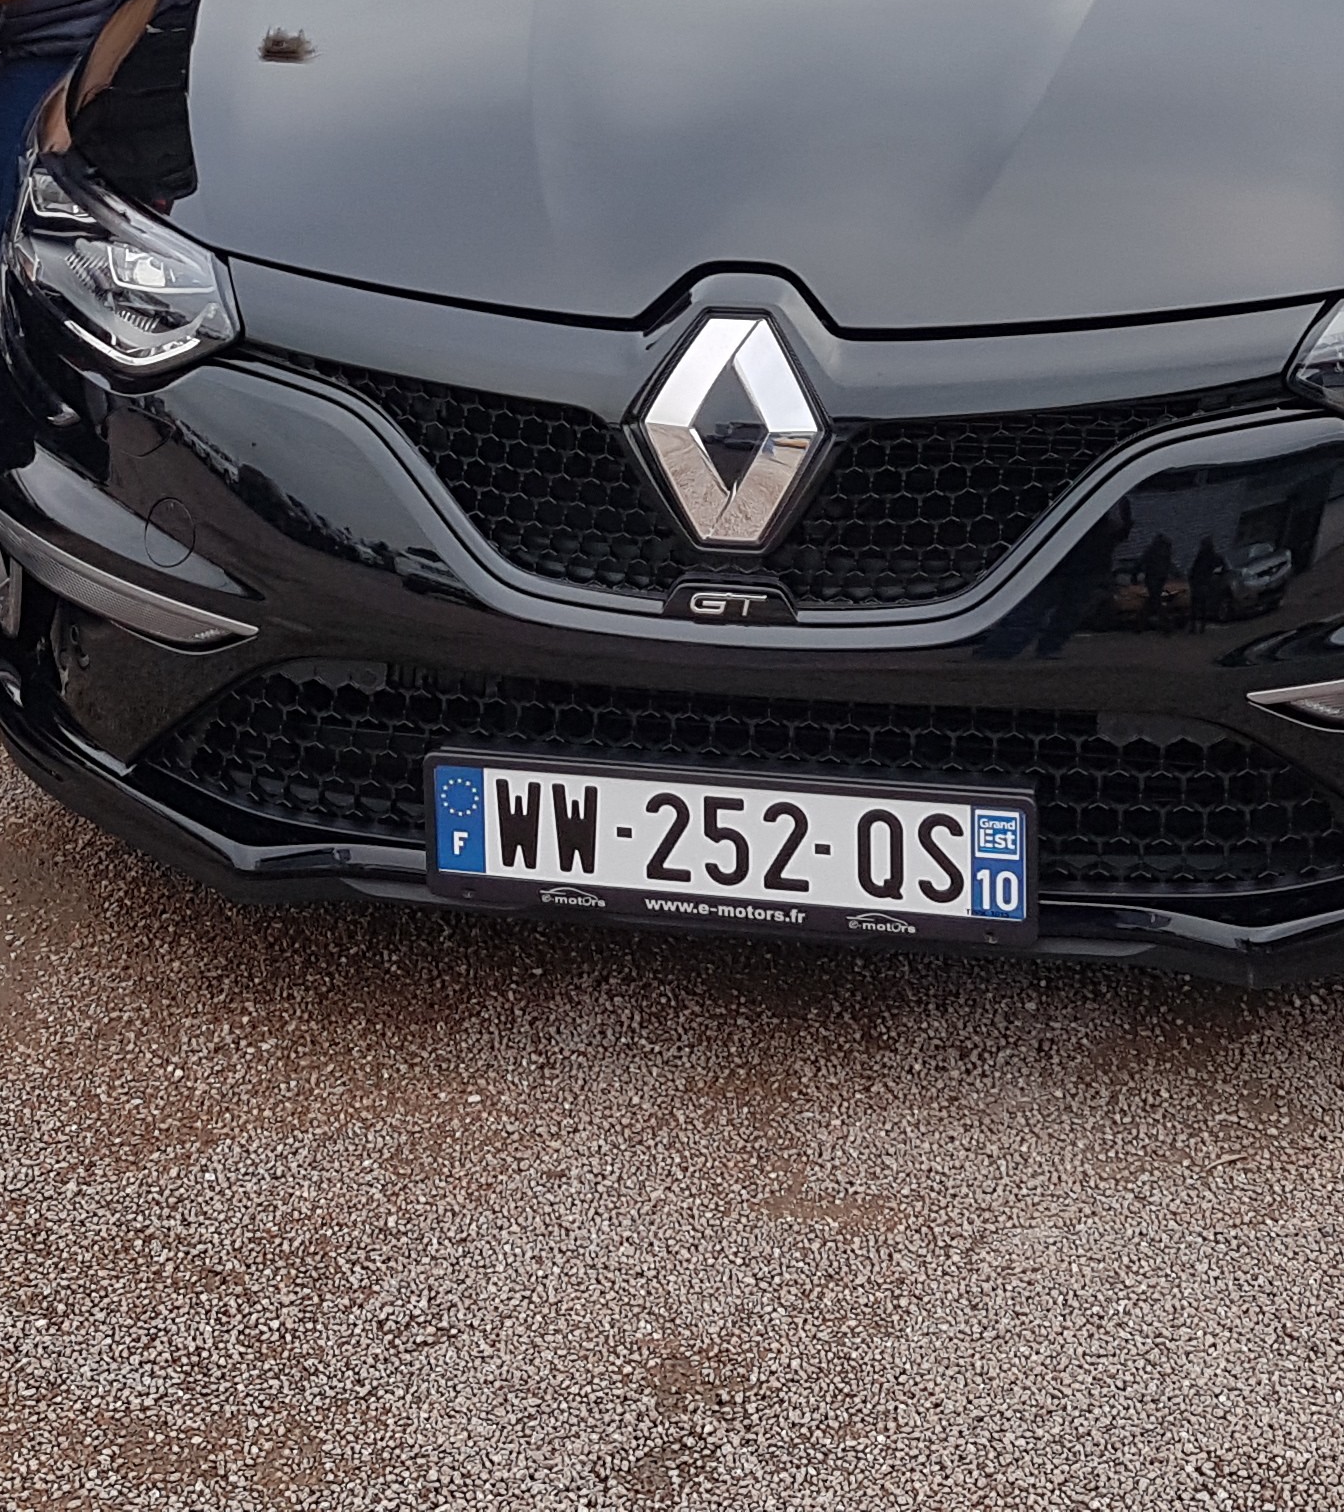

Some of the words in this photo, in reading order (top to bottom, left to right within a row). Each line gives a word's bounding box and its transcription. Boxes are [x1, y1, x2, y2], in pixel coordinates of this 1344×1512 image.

[689, 592, 768, 617] GT
[979, 818, 1016, 831] Grand
[453, 831, 469, 855] F
[495, 778, 965, 904] WW-252-QS
[979, 828, 1016, 849] Est
[541, 893, 606, 908] e-motors
[976, 869, 1019, 912] 10
[644, 897, 806, 924] www.e-motors.fr
[848, 919, 917, 934] e-motors
